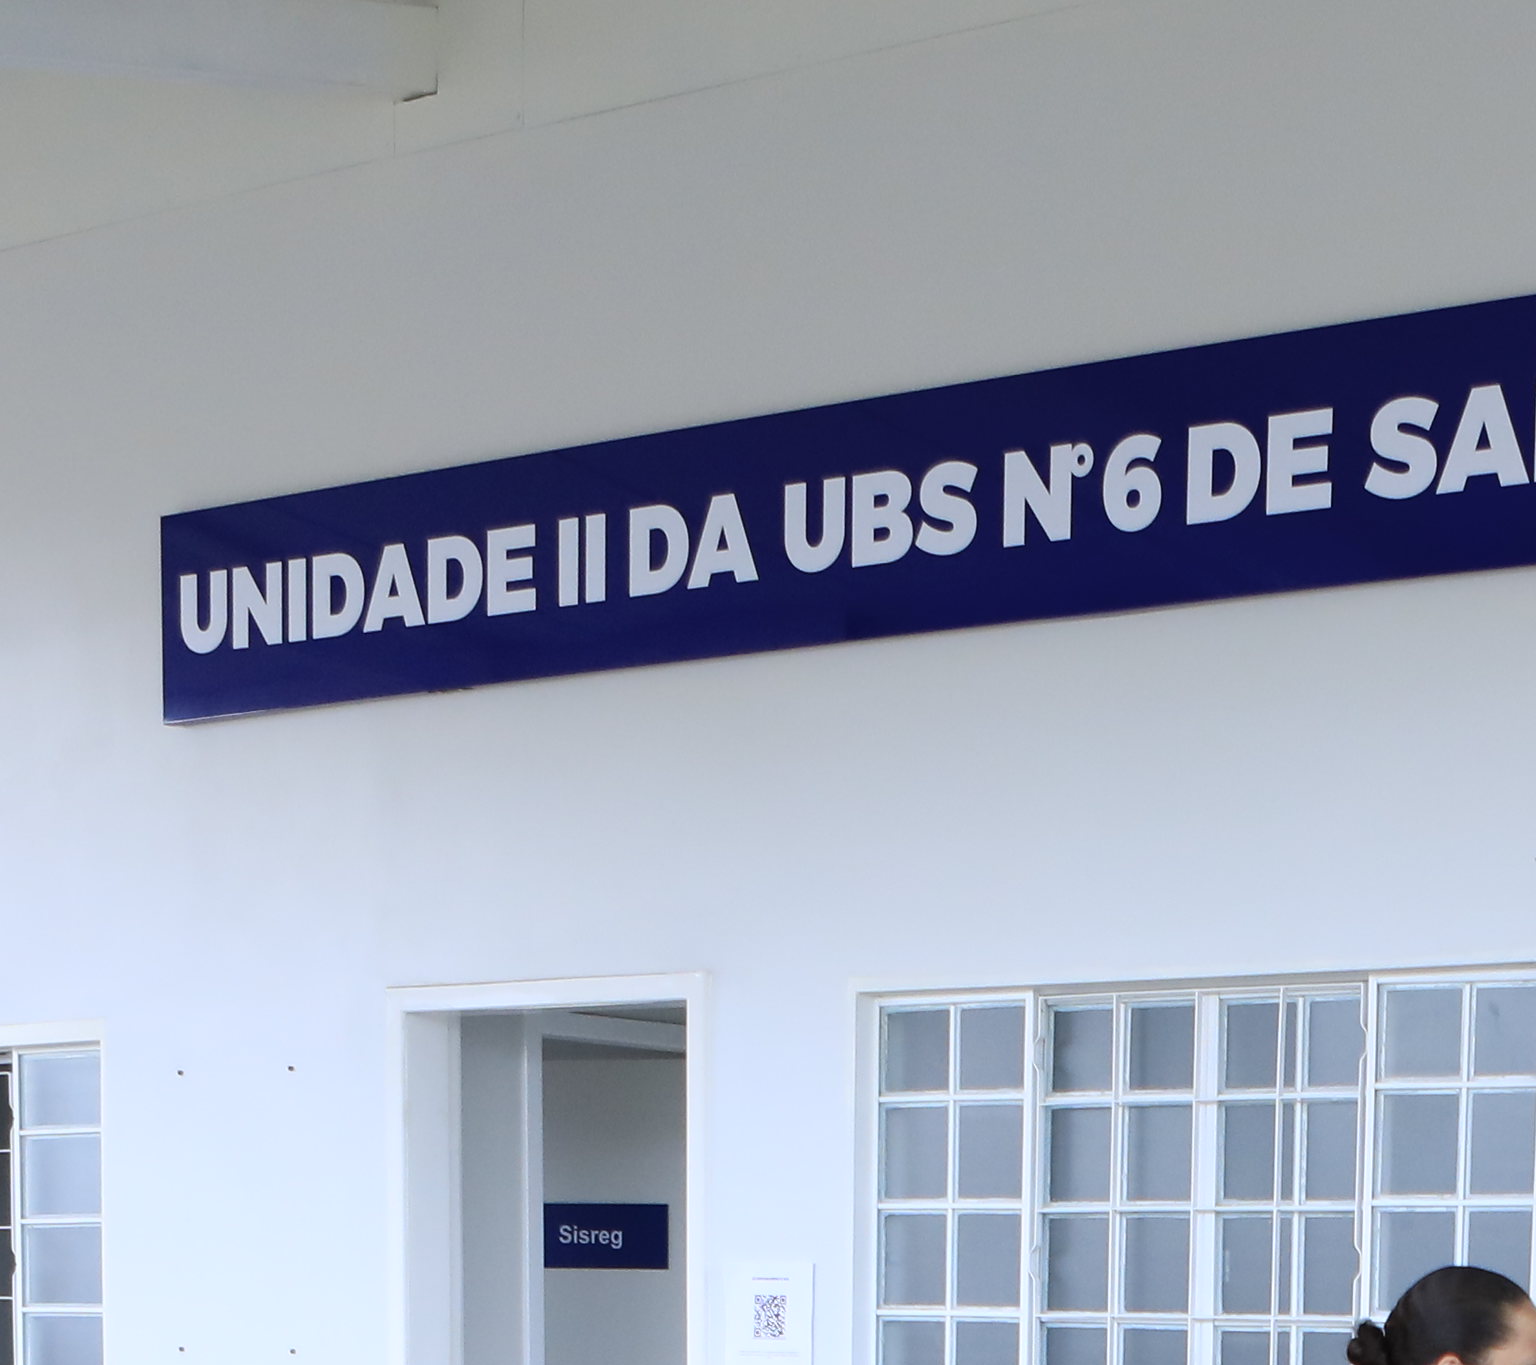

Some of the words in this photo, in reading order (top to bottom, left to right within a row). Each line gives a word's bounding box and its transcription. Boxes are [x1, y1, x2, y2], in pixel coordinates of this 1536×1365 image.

[178, 524, 536, 656] UNIDADE
[558, 513, 607, 607] II
[628, 493, 759, 596] DA
[783, 460, 979, 575] UBS
[1102, 432, 1163, 534] 6
[1186, 406, 1336, 527] DE
[559, 1224, 624, 1249] Sisreg
